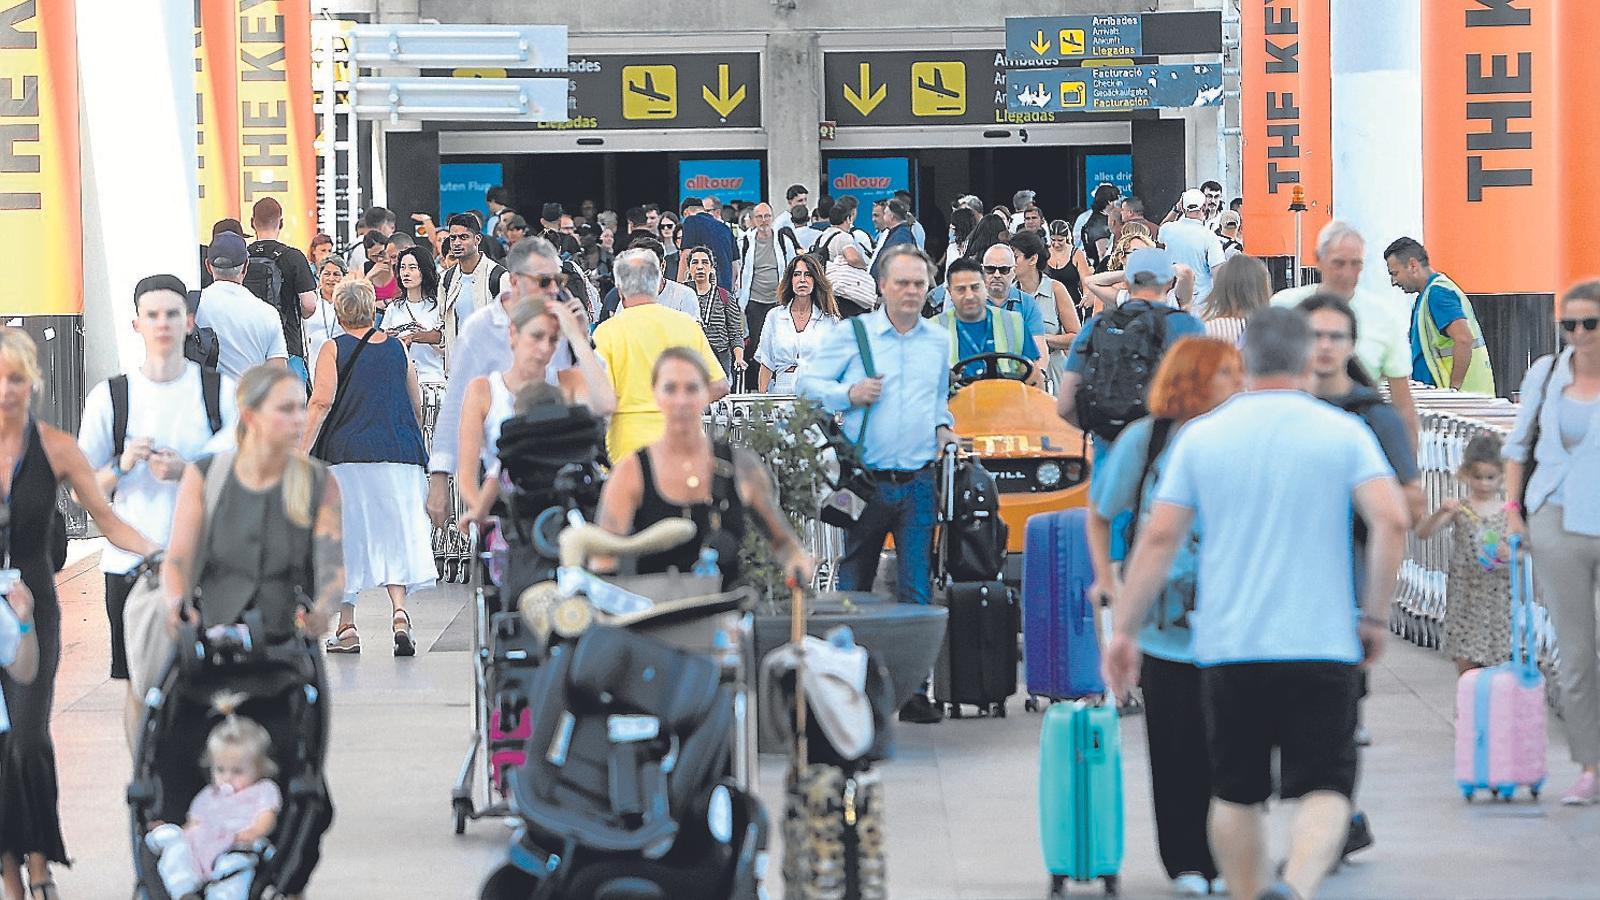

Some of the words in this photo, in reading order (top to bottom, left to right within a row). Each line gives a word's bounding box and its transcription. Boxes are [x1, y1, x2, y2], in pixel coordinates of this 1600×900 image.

[1093, 15, 1138, 26] Arribades
[240, 0, 286, 81] KE
[1092, 46, 1136, 56] Llegadas
[1092, 68, 1142, 78] Facturació
[1094, 97, 1149, 107] Facturación
[1466, 52, 1532, 202] THE
[243, 100, 288, 202] THE
